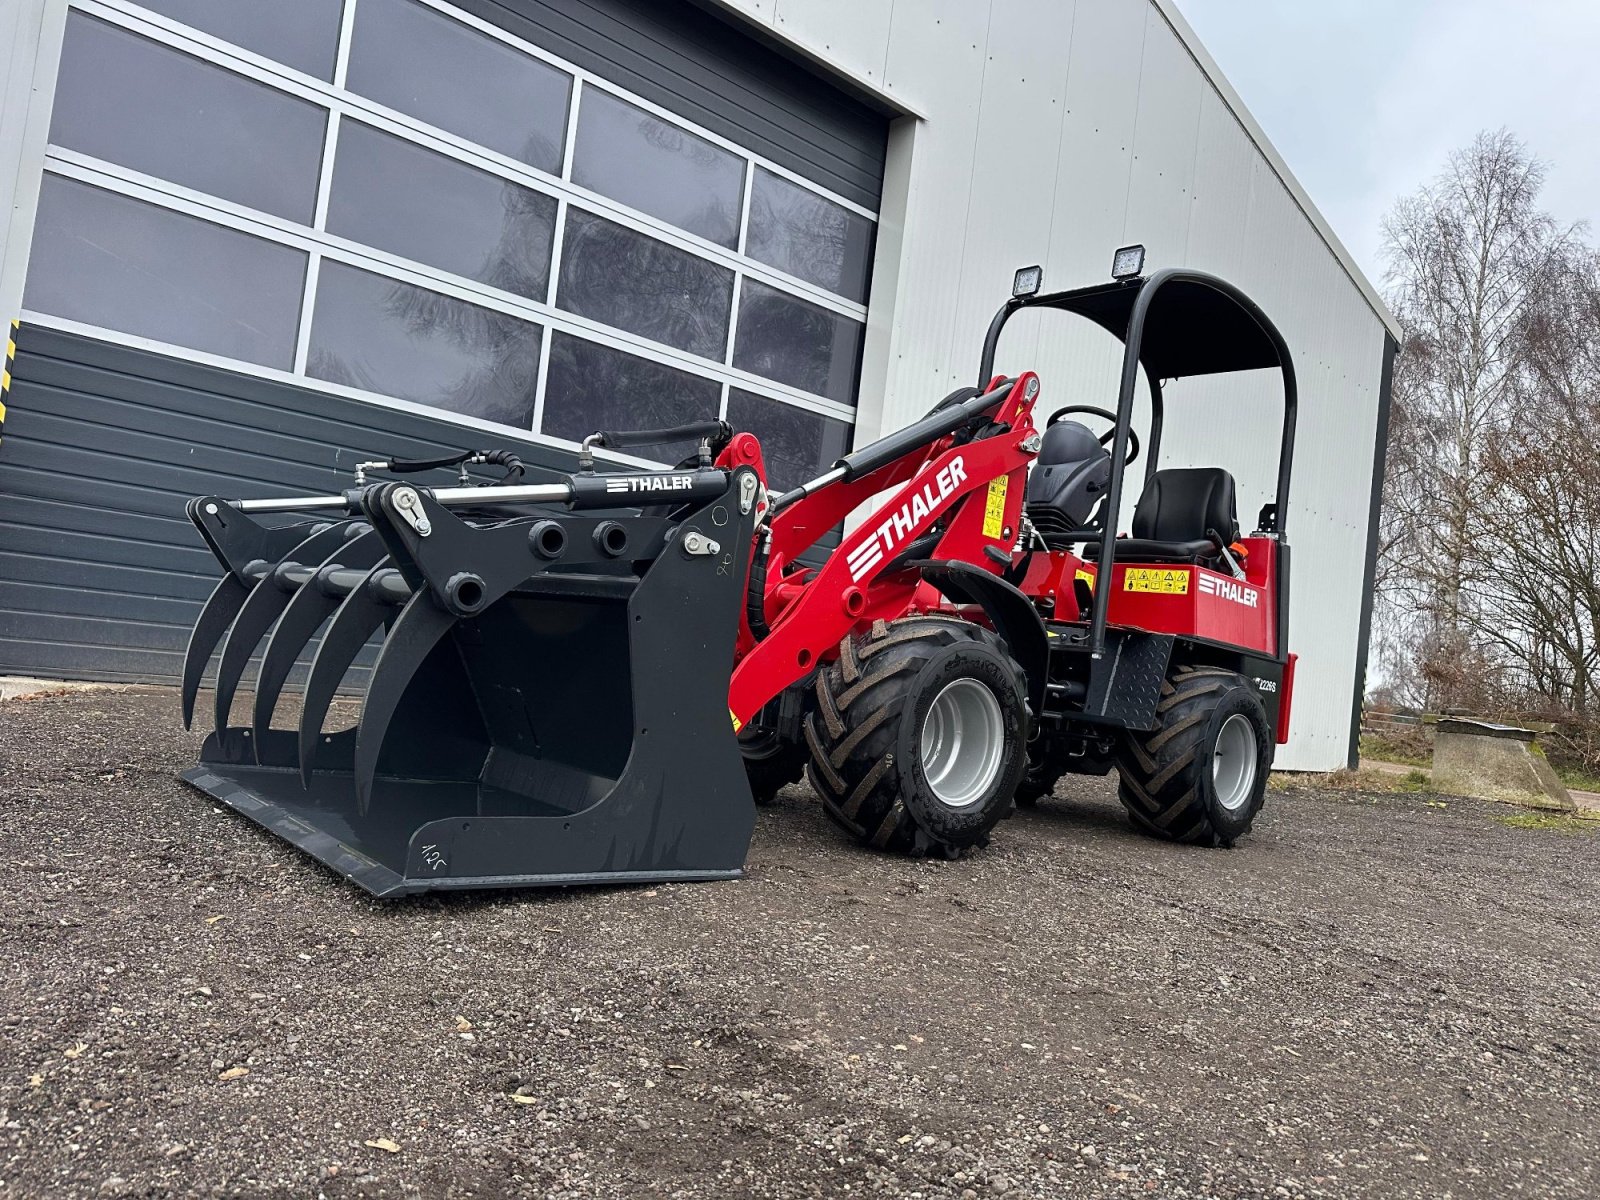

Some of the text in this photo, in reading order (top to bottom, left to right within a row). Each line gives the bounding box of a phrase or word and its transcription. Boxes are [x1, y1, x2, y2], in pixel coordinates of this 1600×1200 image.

[627, 476, 693, 492] THALER
[877, 456, 968, 551] THALER
[1214, 578, 1258, 608] THALER
